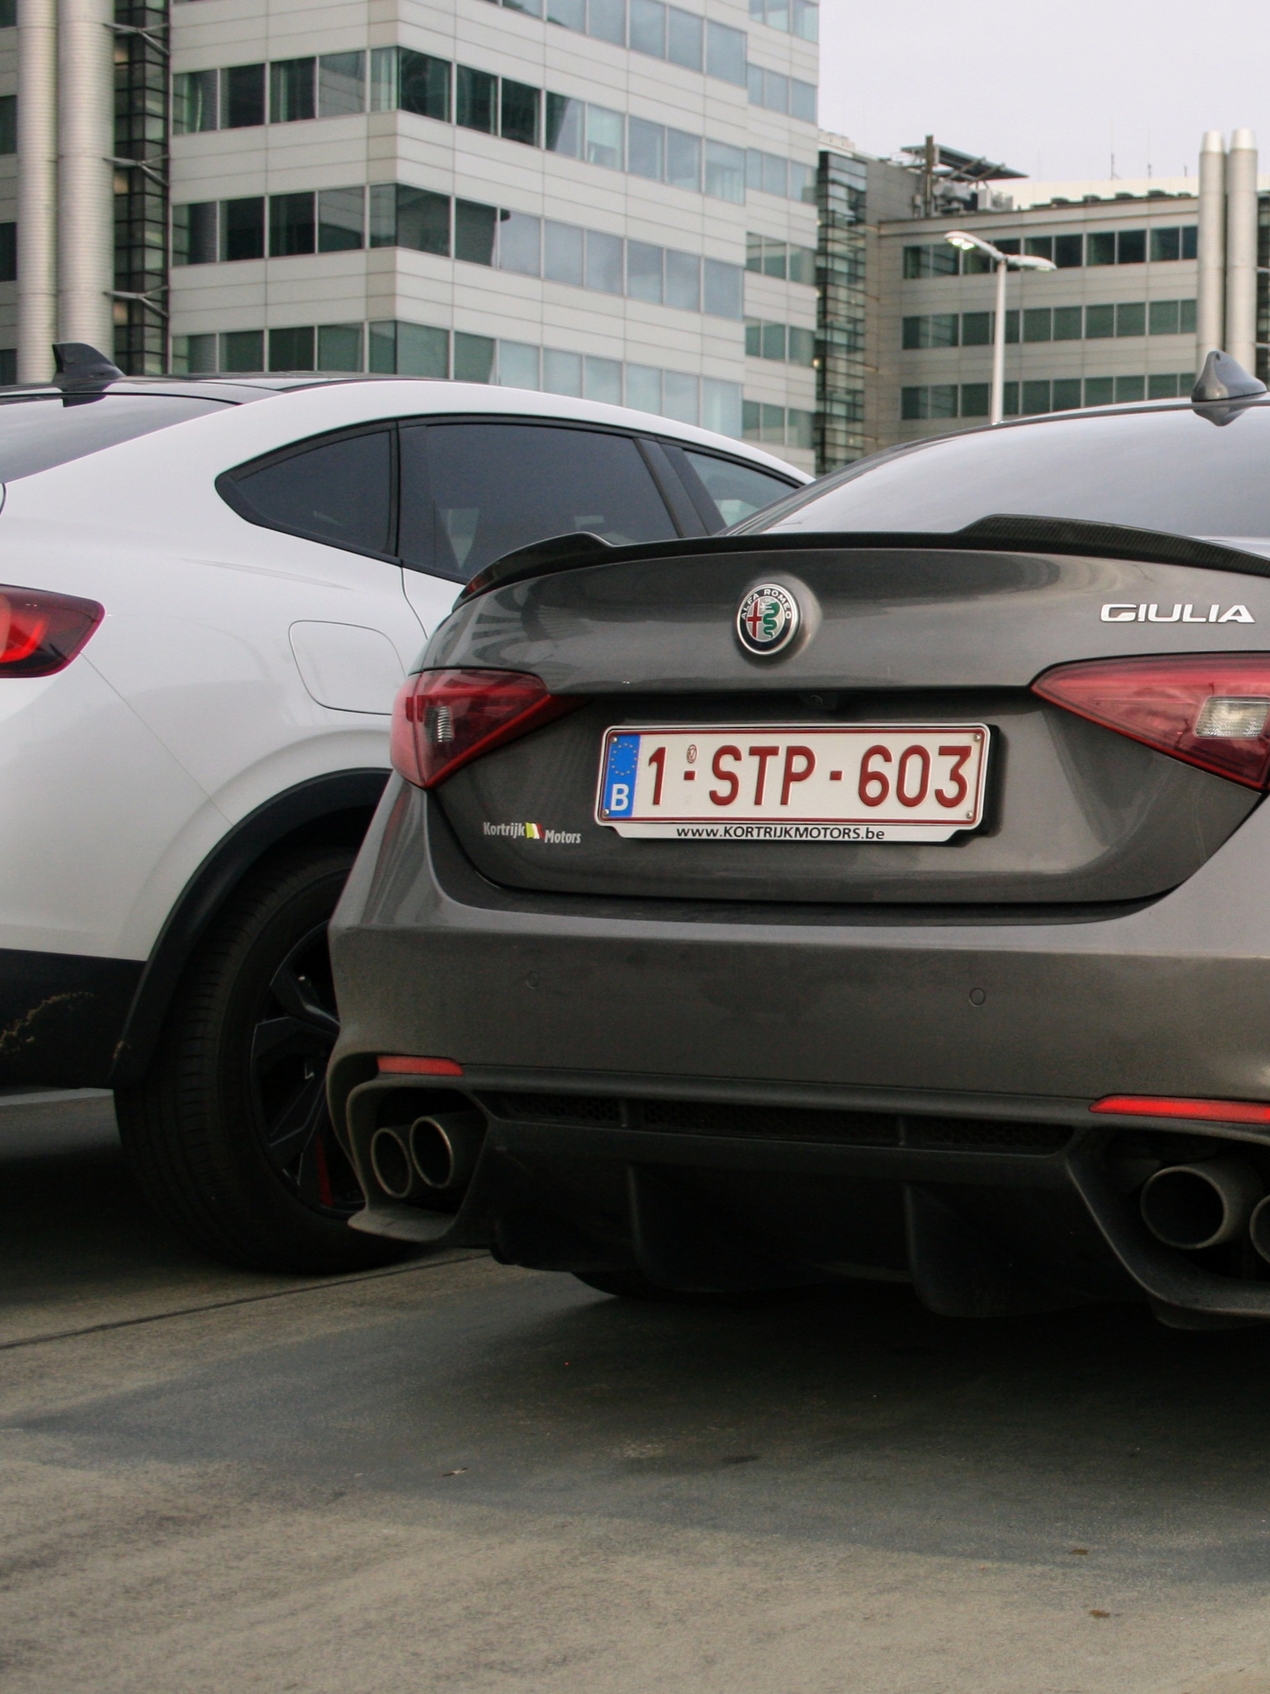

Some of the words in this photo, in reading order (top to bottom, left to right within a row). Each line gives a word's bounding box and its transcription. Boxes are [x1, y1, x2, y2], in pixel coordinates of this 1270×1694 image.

[741, 593, 760, 620] ALFA
[764, 588, 792, 620] ROMEO
[1101, 604, 1255, 623] GIULIA
[648, 744, 972, 808] 1-STP-603
[610, 784, 630, 811] B
[483, 822, 525, 839] Kortrijk
[544, 830, 581, 844] Motors
[676, 826, 885, 840] www.KORTRIJKMOTORS.be
